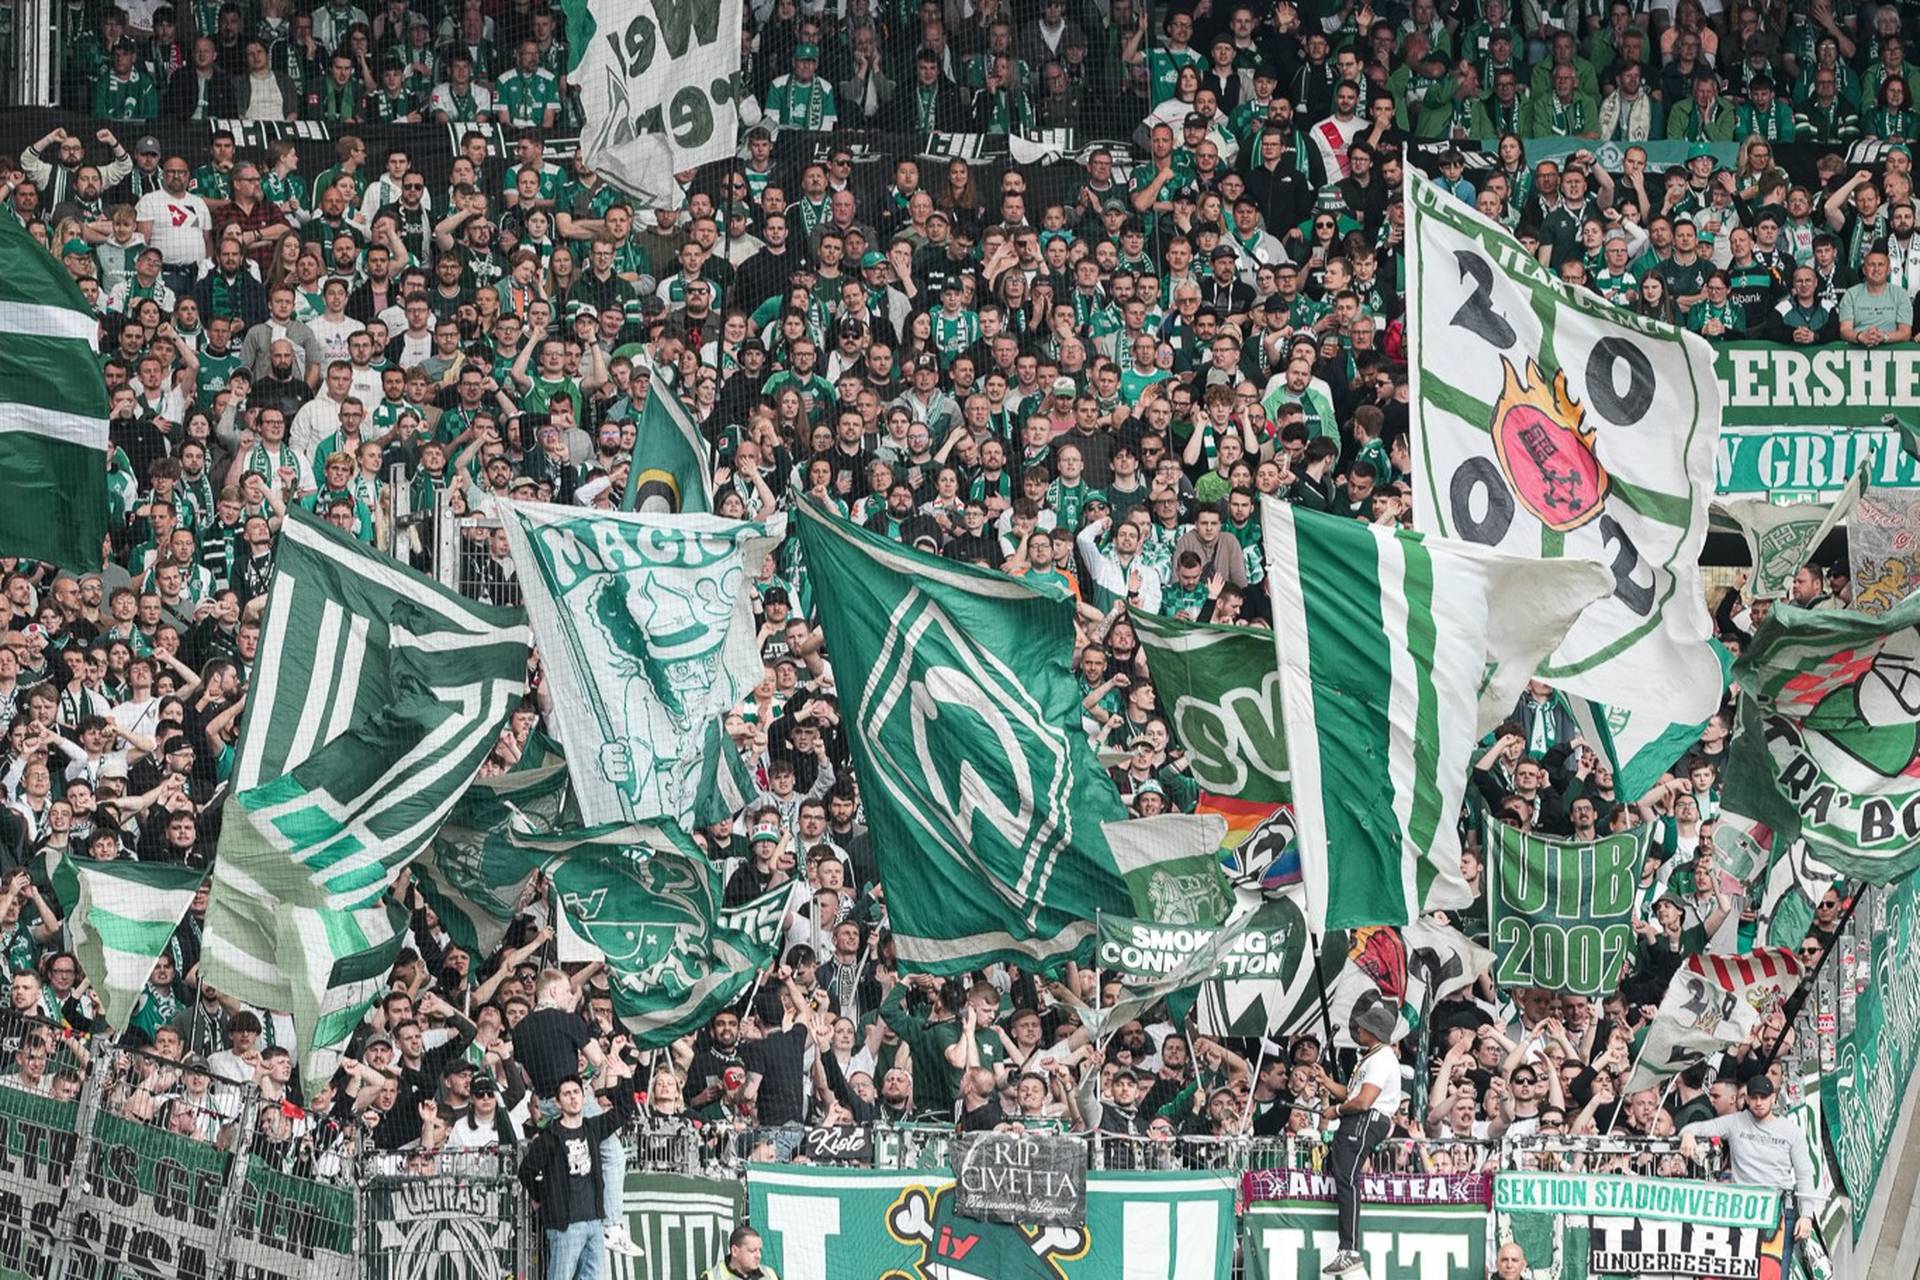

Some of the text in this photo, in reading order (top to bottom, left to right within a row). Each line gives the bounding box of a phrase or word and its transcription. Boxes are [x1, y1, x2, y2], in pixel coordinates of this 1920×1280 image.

[1132, 925, 1267, 954] SMOKNG
[1497, 916, 1629, 994] 2002
[1101, 941, 1283, 978] CONNTION
[808, 1127, 866, 1156] Kiste
[994, 1142, 1040, 1167] RIP
[401, 1178, 487, 1216] ULTRAS
[961, 1166, 1078, 1198] CIVETTA
[1289, 1171, 1449, 1201] AMNTEA
[1498, 1177, 1773, 1222] SEKTION STADIONVERBOT
[1595, 1252, 1758, 1279] UNVERGESSEN
